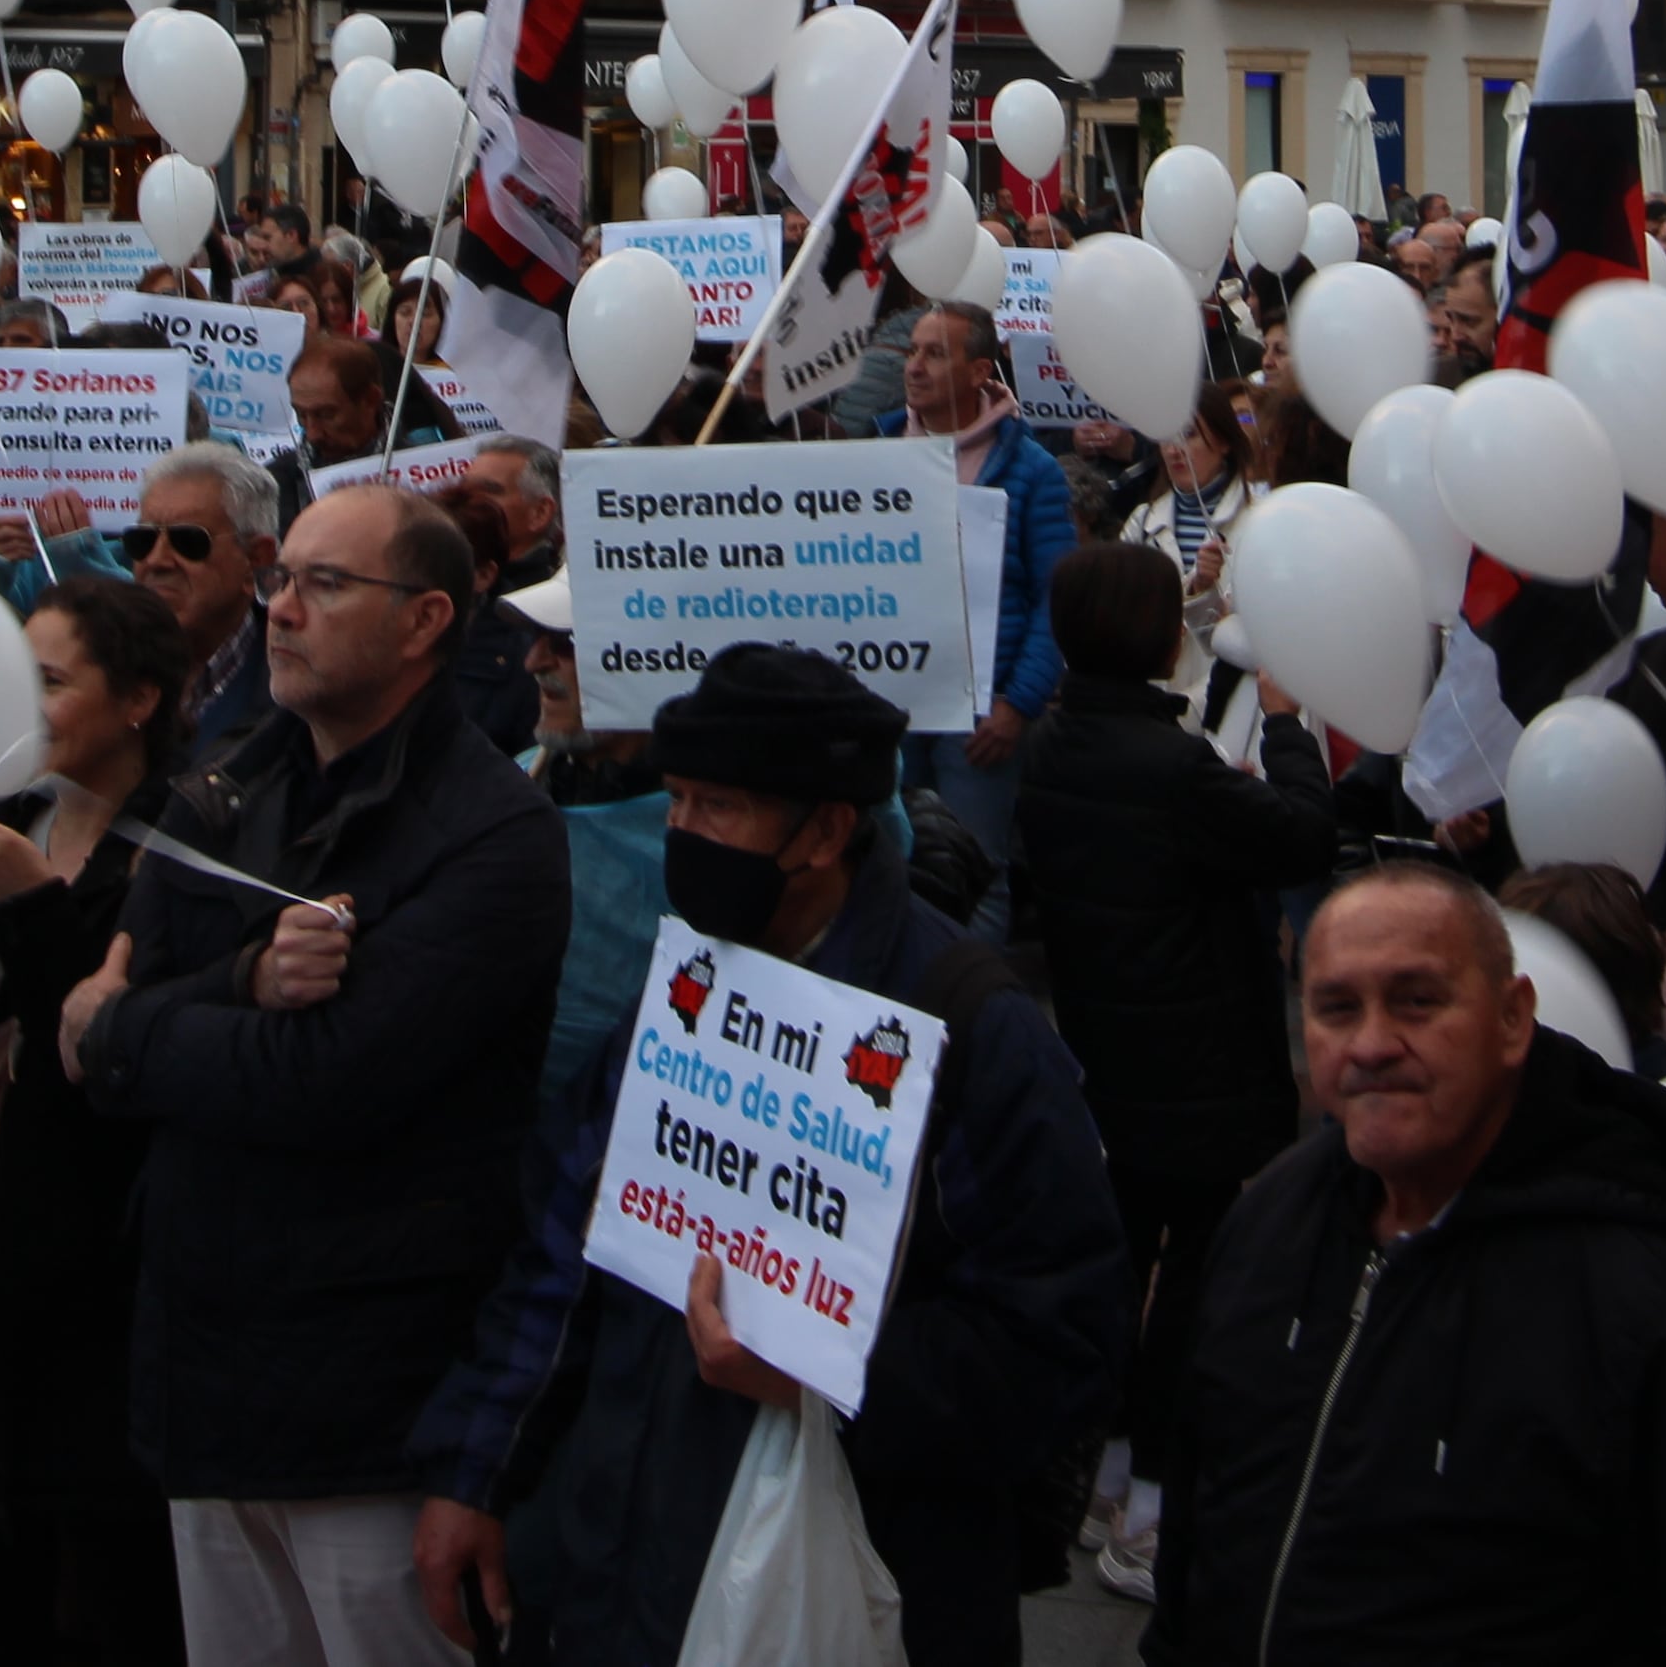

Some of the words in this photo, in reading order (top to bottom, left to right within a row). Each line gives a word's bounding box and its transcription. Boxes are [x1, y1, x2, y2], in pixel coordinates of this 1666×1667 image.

[951, 68, 982, 92] 957
[1141, 70, 1176, 89] YORK
[46, 234, 70, 246] Las
[73, 233, 111, 246] obras
[115, 232, 132, 245] de
[22, 248, 76, 262] reforma
[79, 247, 102, 260] del
[104, 247, 159, 261] hospital
[705, 250, 766, 277] AQUÍ
[43, 262, 83, 275] Santa
[1011, 259, 1033, 275] mi
[27, 277, 86, 291] volverán
[688, 280, 754, 302] ANTO
[53, 293, 90, 305] hasta
[695, 306, 741, 326] AR!
[200, 320, 259, 346] NOS
[225, 348, 283, 375] NOS
[32, 367, 158, 394] Sorianos
[64, 405, 113, 425] para
[119, 402, 162, 426] pri-
[89, 434, 173, 453] externa
[65, 467, 115, 482] espera
[118, 465, 138, 481] de
[408, 455, 472, 484] Soria
[84, 495, 116, 510] edia
[595, 484, 784, 524] Esperando
[794, 488, 862, 520] que
[872, 486, 914, 513] se
[593, 537, 709, 570] instale
[719, 541, 785, 569] una
[794, 531, 923, 566] unidad
[623, 588, 667, 620] de
[677, 585, 899, 624] radioterapia
[600, 640, 708, 672] desde
[836, 640, 932, 672] 2007
[720, 989, 765, 1054] En
[770, 1020, 824, 1076] mi
[635, 1026, 733, 1106] Centro
[740, 1072, 782, 1128] de
[788, 1092, 893, 1189] Salud,
[654, 1098, 759, 1196] tener
[768, 1156, 849, 1241] cita
[619, 1178, 801, 1297] está-a-años
[802, 1255, 856, 1328] luz
